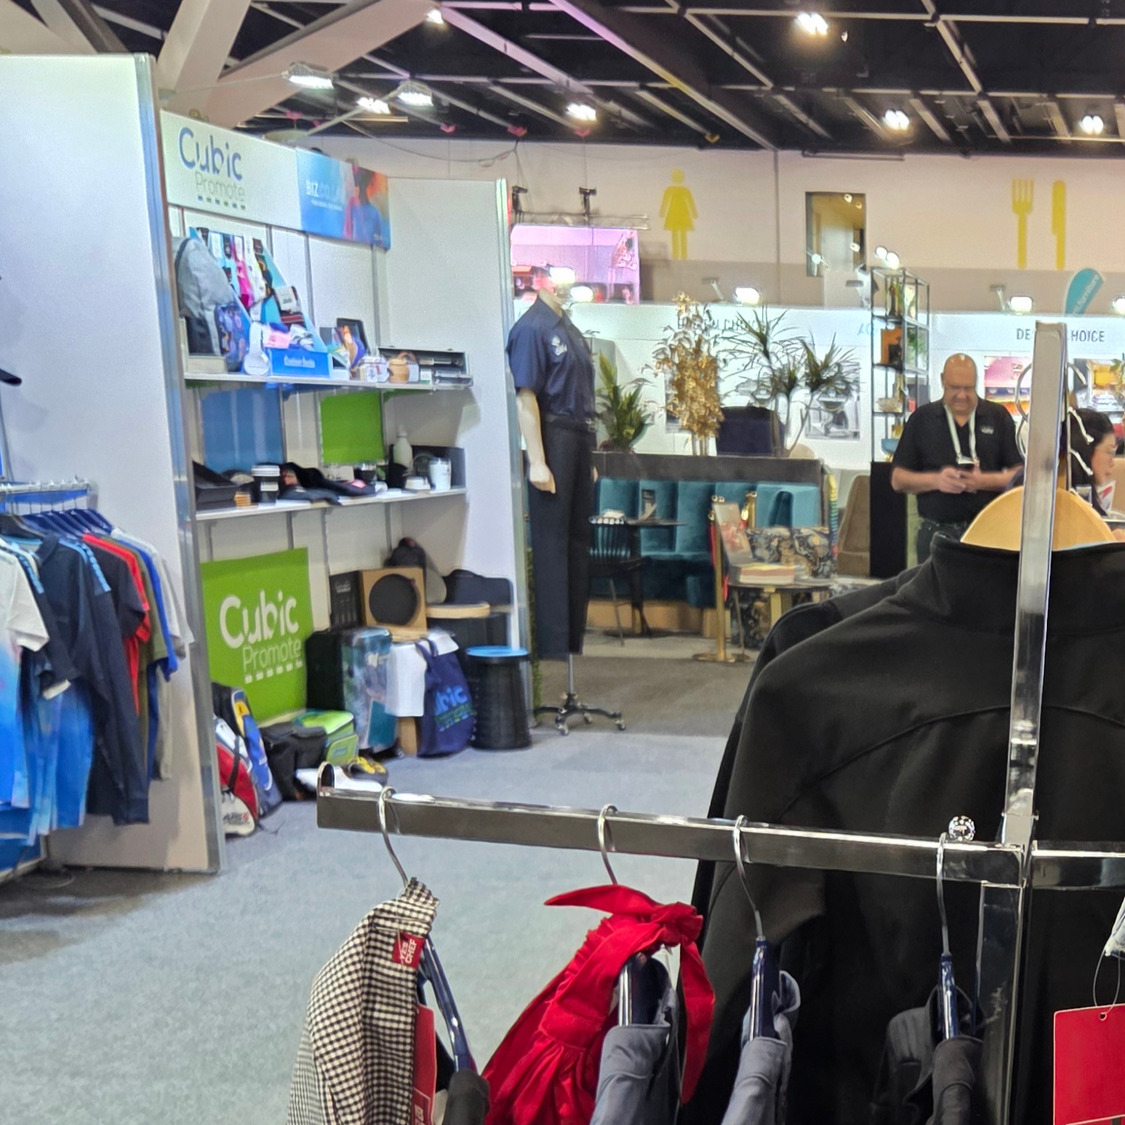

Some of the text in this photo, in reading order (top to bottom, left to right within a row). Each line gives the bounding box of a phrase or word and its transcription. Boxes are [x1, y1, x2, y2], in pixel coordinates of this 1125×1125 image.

[179, 127, 243, 180] Cubic
[195, 171, 245, 199] Promote
[1070, 330, 1105, 342] HOICE
[219, 589, 300, 649] Cubic
[242, 638, 302, 673] Promote
[405, 938, 417, 964] CHEF
